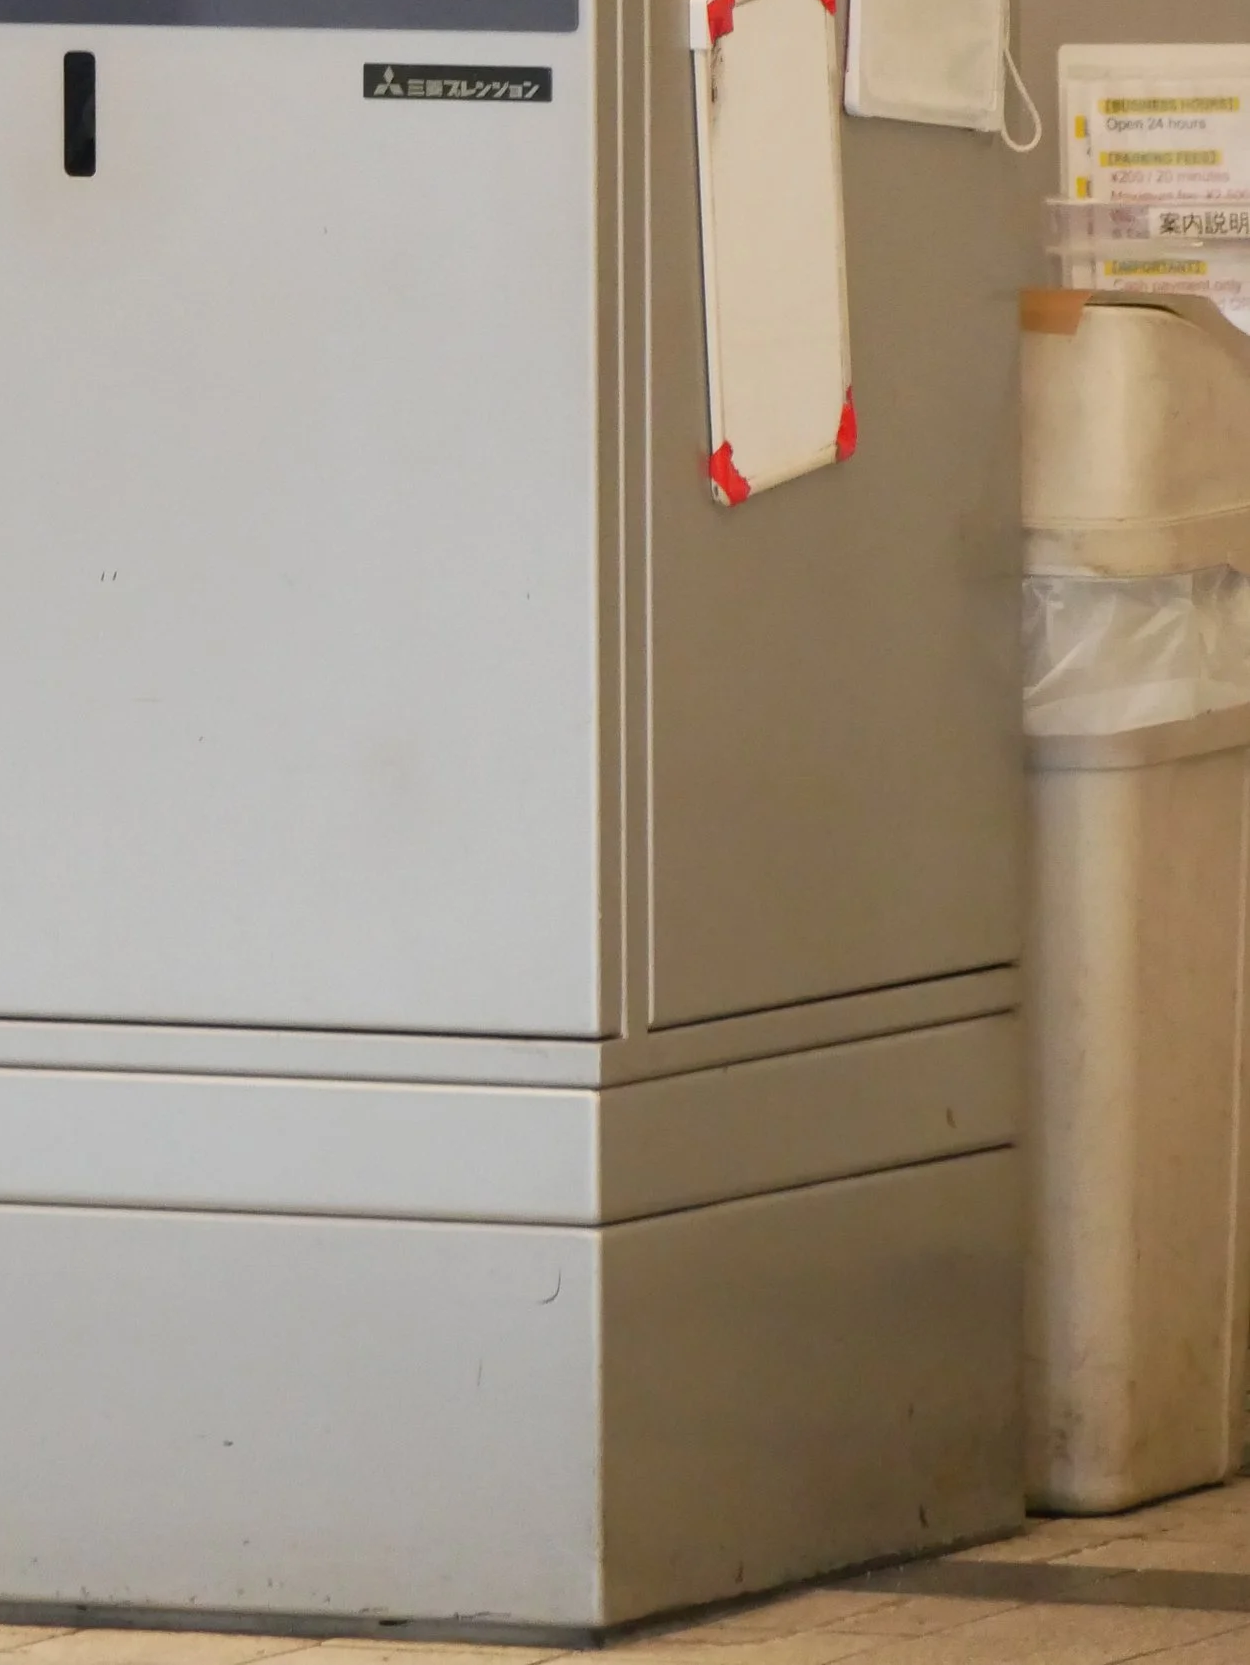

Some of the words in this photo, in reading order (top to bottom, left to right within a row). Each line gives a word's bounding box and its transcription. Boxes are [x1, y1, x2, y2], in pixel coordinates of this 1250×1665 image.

[1106, 117, 1143, 132] Open
[1148, 117, 1164, 129] 24
[1168, 117, 1206, 130] hours
